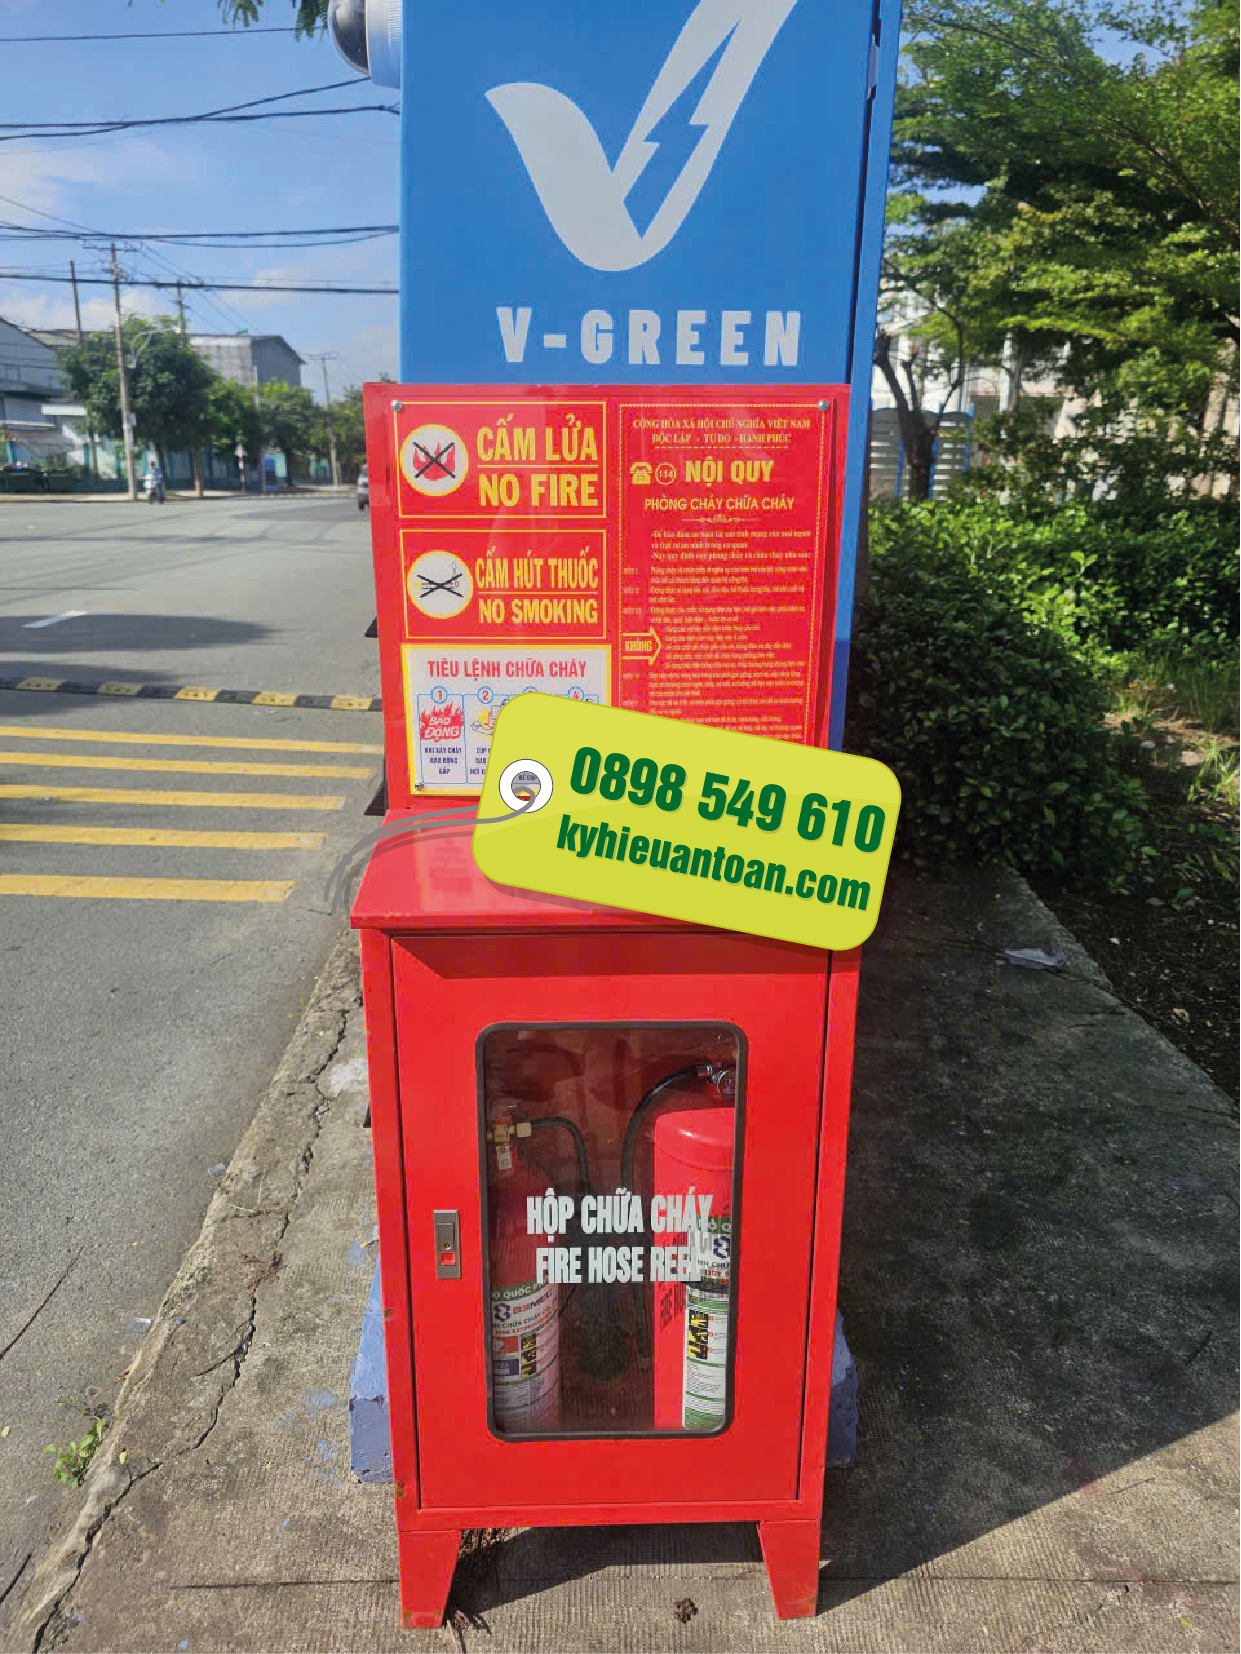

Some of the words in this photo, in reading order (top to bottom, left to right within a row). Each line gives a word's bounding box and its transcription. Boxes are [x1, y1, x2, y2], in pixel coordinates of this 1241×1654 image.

[496, 306, 801, 367] V-GREEN
[477, 412, 536, 462] CẤM
[545, 413, 598, 461] LỬA
[685, 456, 723, 487] NỘI
[731, 460, 774, 484] QUY
[478, 473, 519, 506] NO
[531, 473, 599, 507] FIRE
[645, 493, 687, 510] PHÒNG
[690, 494, 723, 510] CHÁY
[726, 495, 758, 510] CHỮA
[762, 493, 795, 510] CHÁY
[475, 545, 509, 589] CẤM
[513, 549, 543, 589] HÚT
[548, 545, 599, 589] THUỐC
[478, 598, 505, 624] NO
[512, 598, 598, 624] SMOKING
[428, 658, 460, 677] TIÊU
[464, 658, 501, 681] LỆNH
[505, 658, 544, 678] CHỮA
[549, 658, 587, 678] CHÁY
[437, 690, 443, 700] 1
[482, 690, 489, 701] 2
[526, 1187, 574, 1243] HỘP
[580, 1187, 645, 1235] CHỮA
[650, 1186, 714, 1234] CHÁY
[536, 1247, 582, 1284] FIRE
[588, 1246, 644, 1284] HOSE
[650, 1246, 702, 1282] REEL
